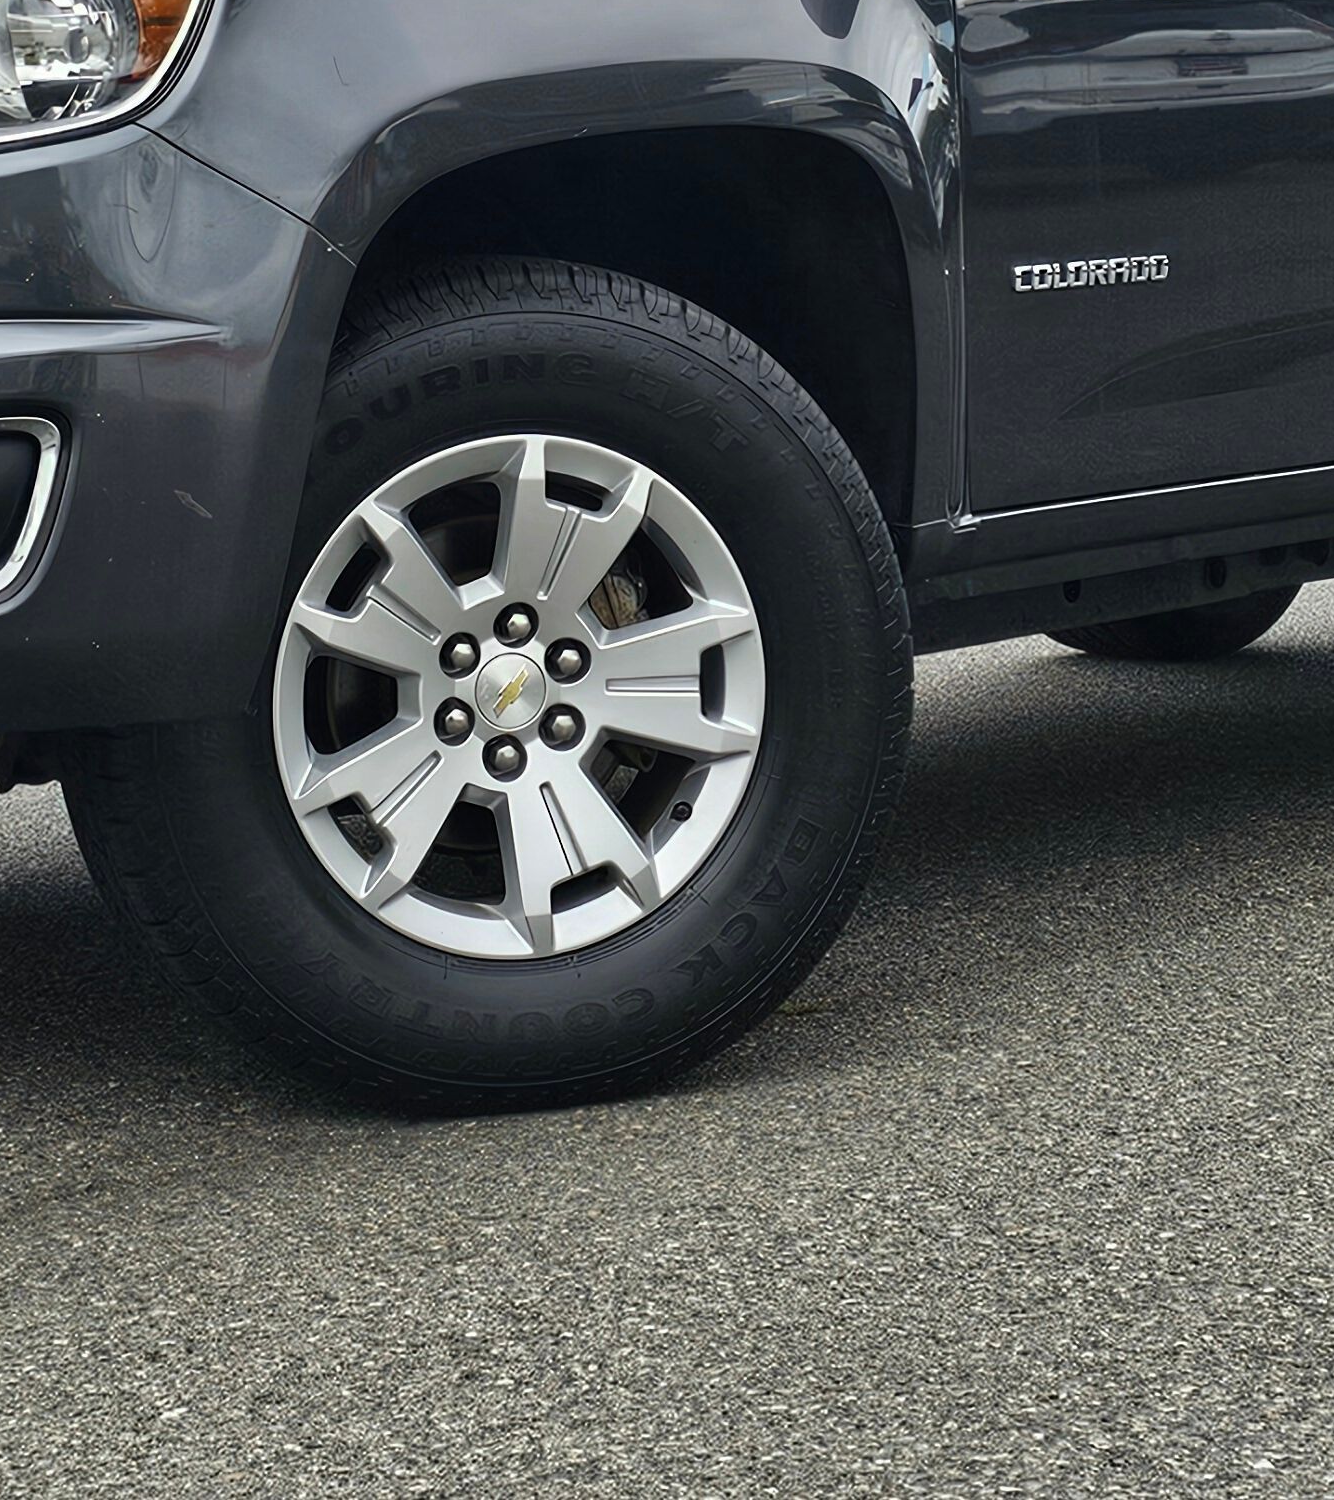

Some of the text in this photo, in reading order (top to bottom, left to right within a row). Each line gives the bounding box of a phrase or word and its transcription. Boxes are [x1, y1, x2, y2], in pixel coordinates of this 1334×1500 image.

[1013, 254, 1170, 293] COLORADO
[323, 350, 601, 456] OURING
[297, 817, 824, 1046] BACK COUNTRY
